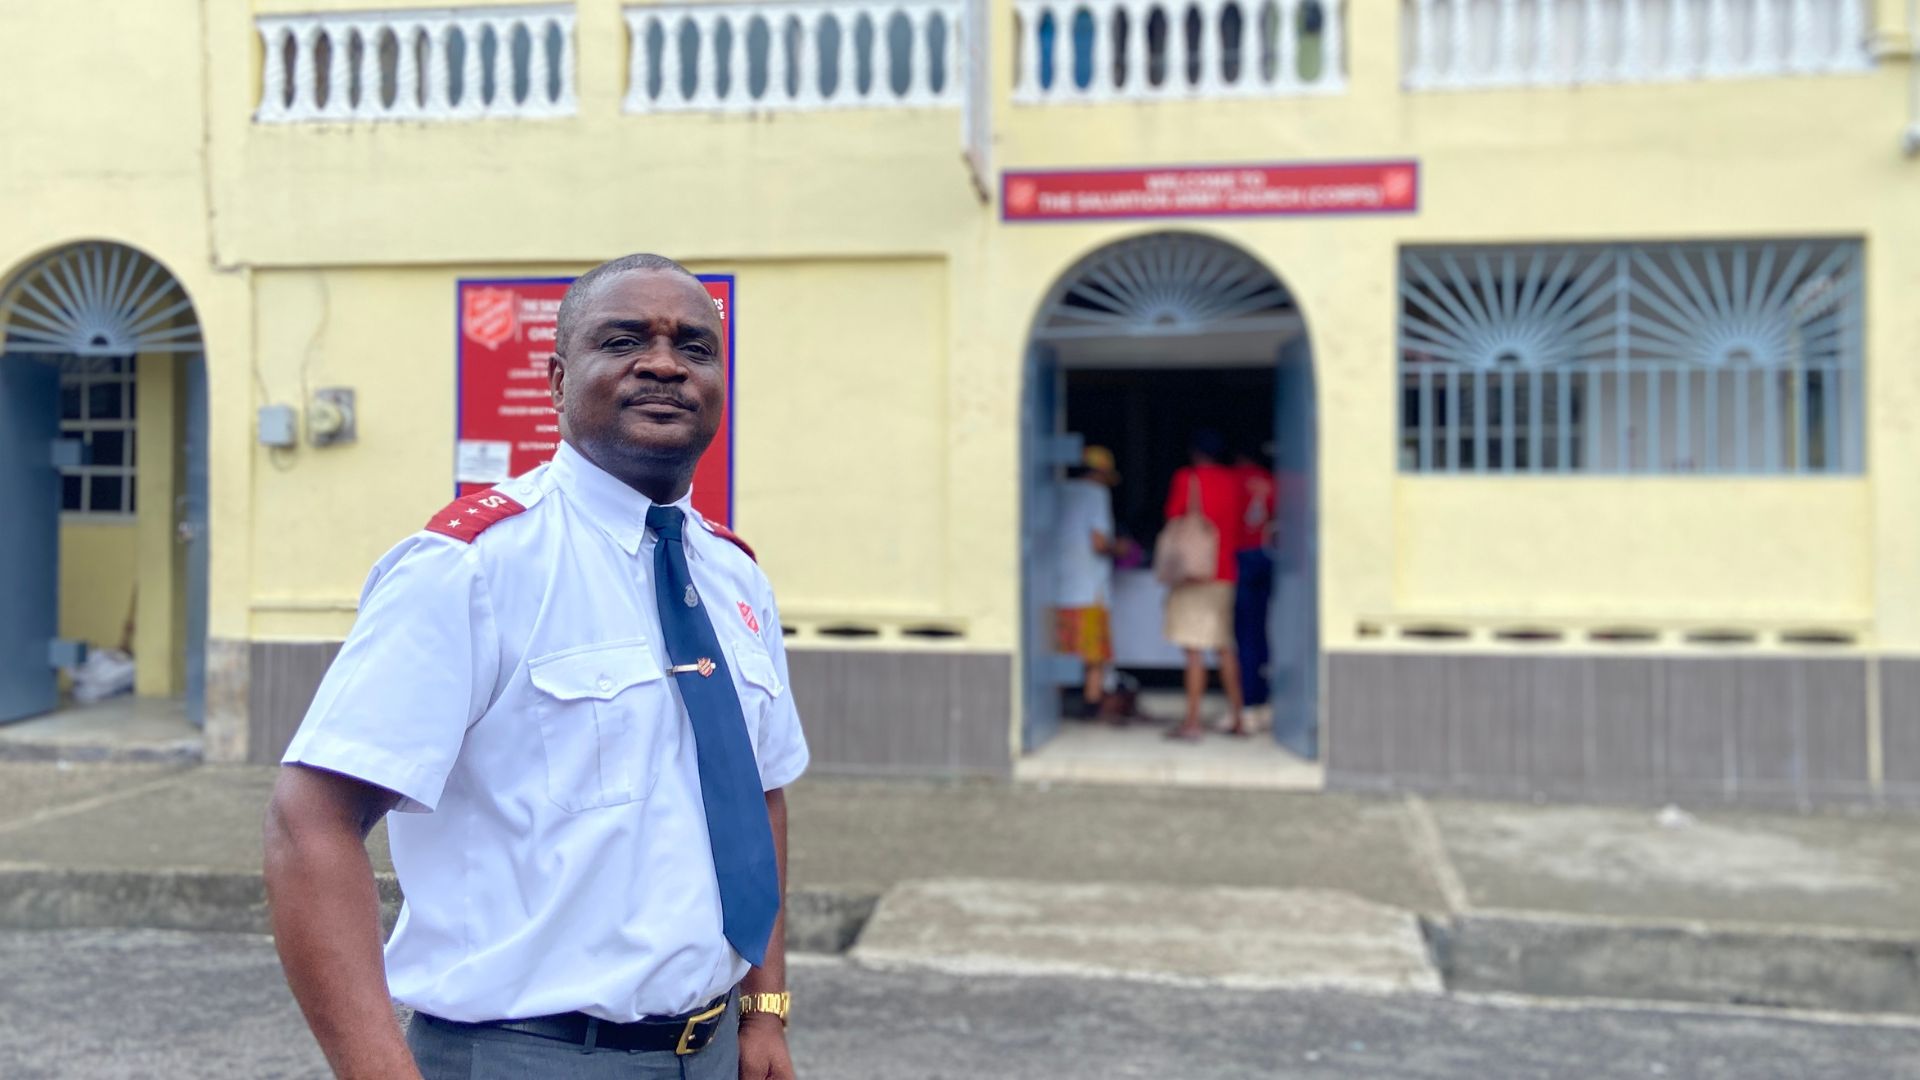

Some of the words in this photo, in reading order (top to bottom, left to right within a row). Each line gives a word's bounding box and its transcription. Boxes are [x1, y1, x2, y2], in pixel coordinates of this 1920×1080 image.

[1146, 171, 1235, 189] WELCOME
[1240, 169, 1266, 187] TO
[1039, 192, 1072, 213] THE
[1077, 190, 1168, 211] SALVATION
[1174, 188, 1222, 208] ARMY
[1226, 186, 1299, 208] CHURCH
